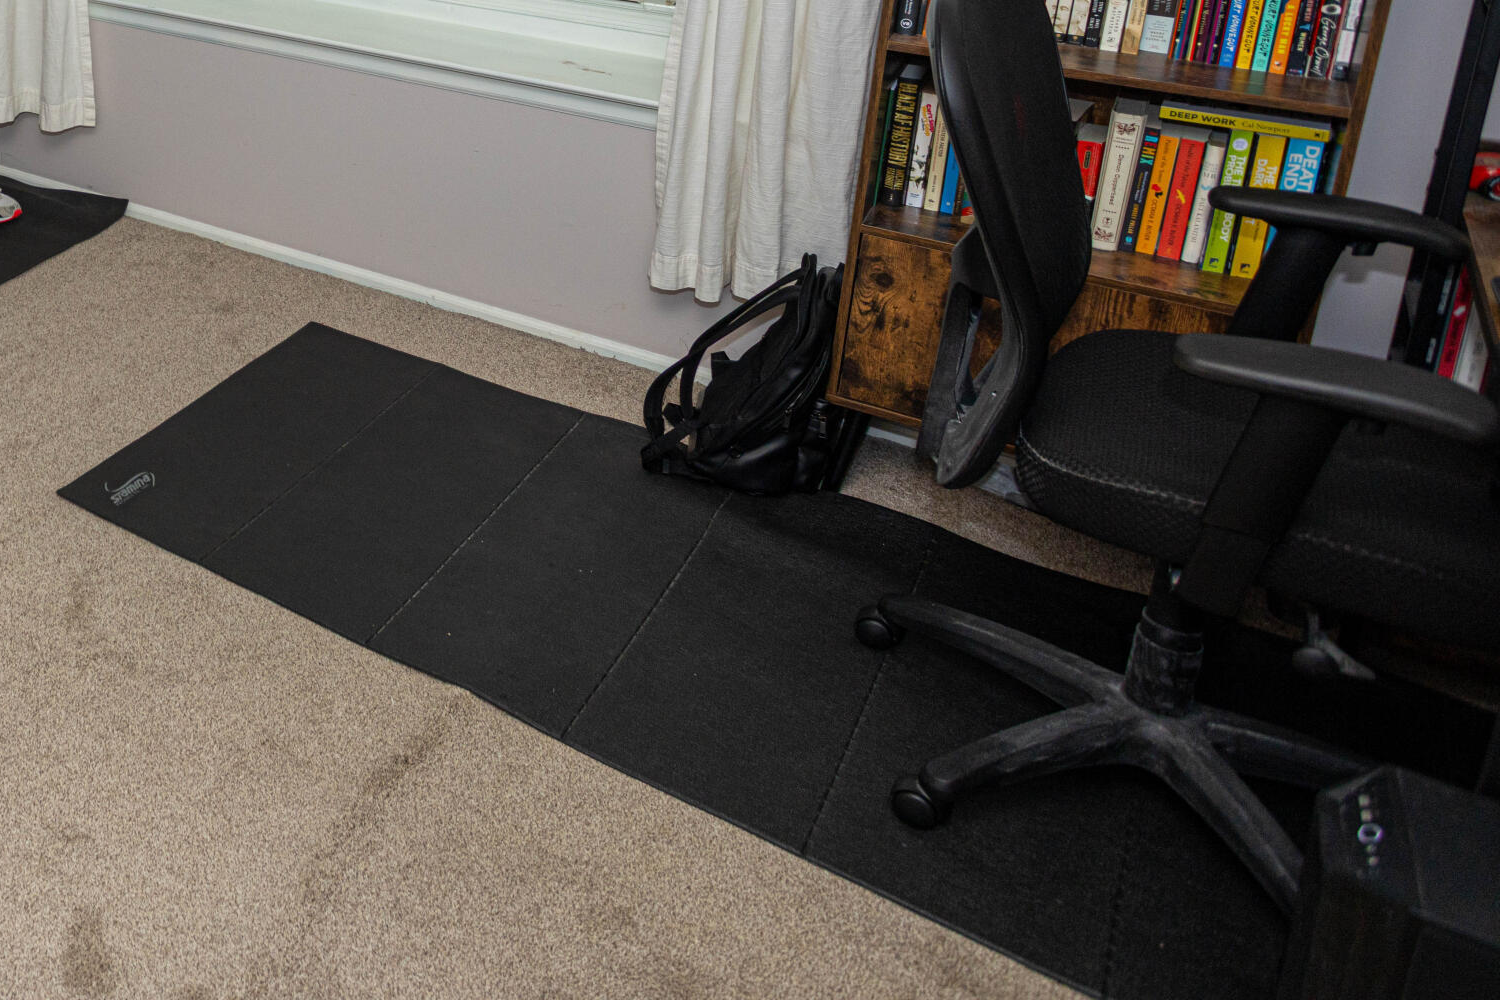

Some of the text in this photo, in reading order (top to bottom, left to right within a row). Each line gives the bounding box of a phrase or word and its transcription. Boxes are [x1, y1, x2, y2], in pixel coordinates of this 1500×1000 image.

[1226, 14, 1239, 51] VONNEGUT
[1244, 15, 1256, 52] VONNEGUT
[1260, 19, 1273, 56] VONNEGUT
[1297, 31, 1306, 51] WOMEN
[1318, 16, 1336, 47] George
[1312, 46, 1330, 76] Orwell
[888, 82, 917, 167] BLACK AF HISTORY
[1169, 110, 1291, 134] DEEP WORK Cal Newport
[1234, 156, 1247, 177] THE
[1252, 158, 1269, 186] DARK
[1264, 165, 1278, 185] THE
[1283, 153, 1304, 190] END
[1297, 145, 1321, 193] DEAT
[1144, 225, 1152, 240] BUTLER
[1220, 212, 1232, 242] BODY
[110, 473, 152, 505] Stamina
